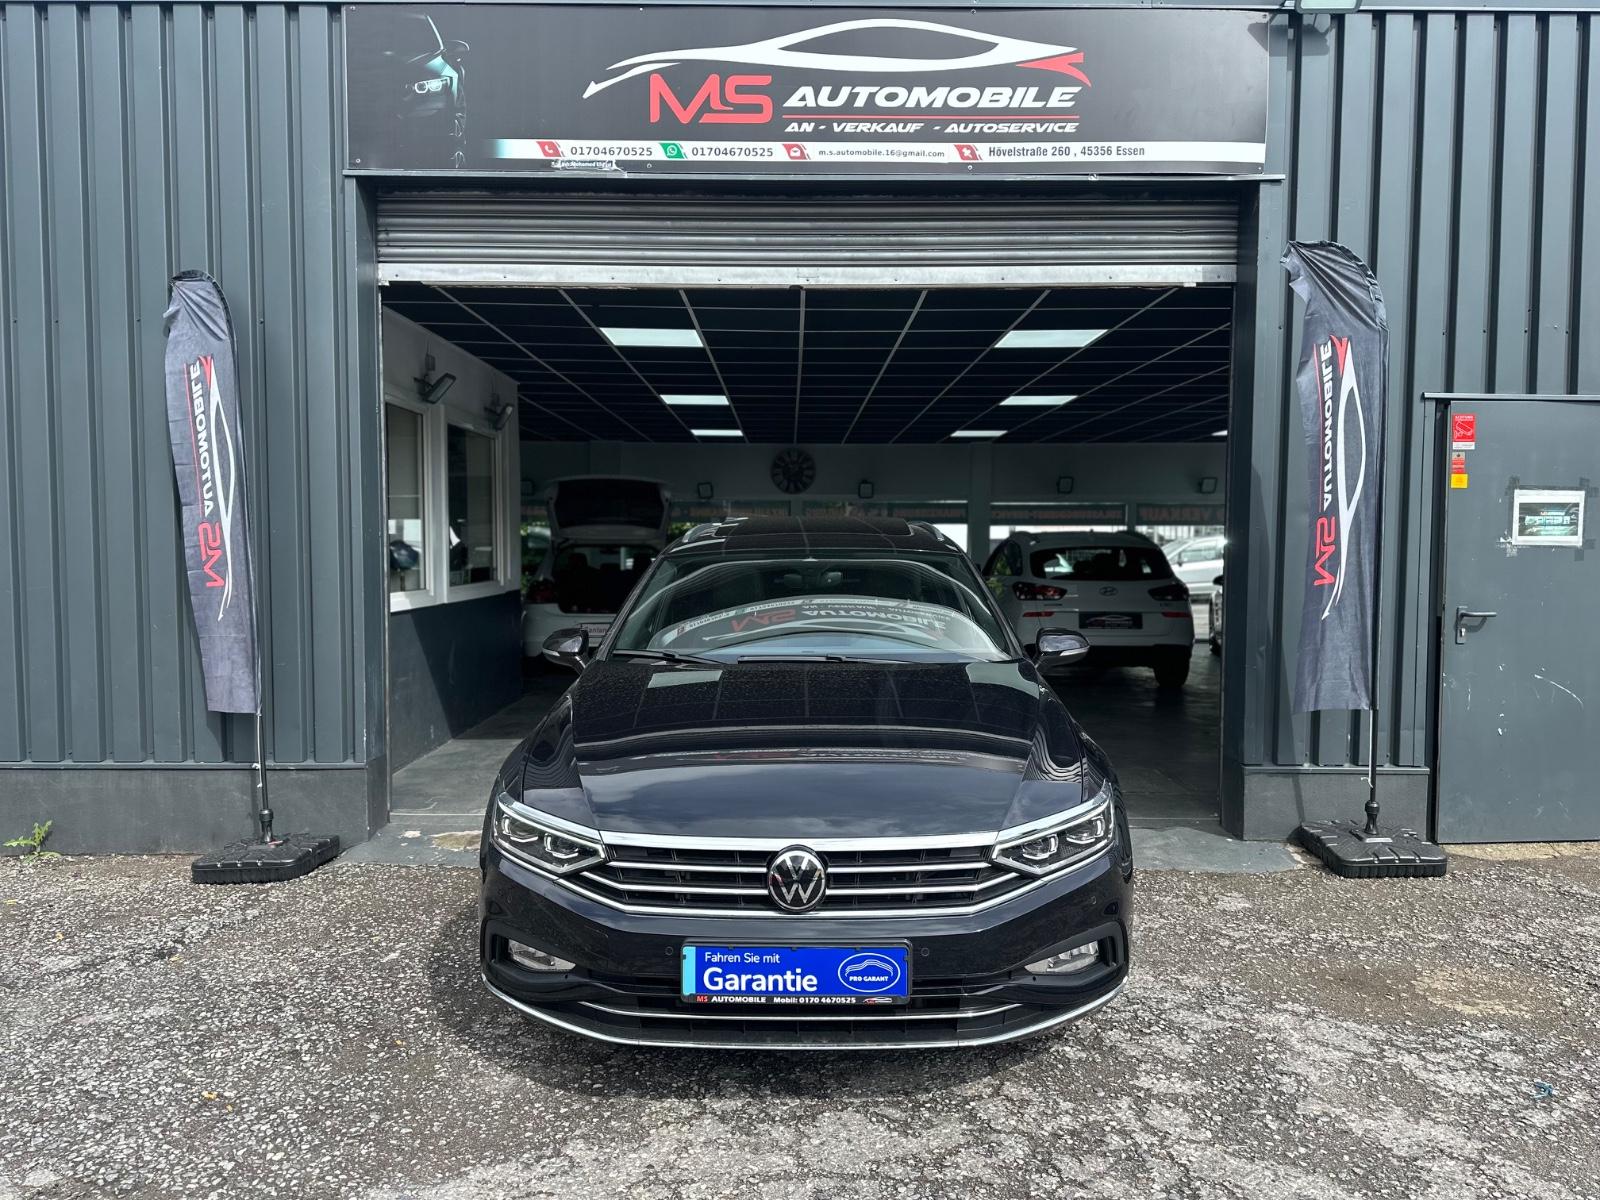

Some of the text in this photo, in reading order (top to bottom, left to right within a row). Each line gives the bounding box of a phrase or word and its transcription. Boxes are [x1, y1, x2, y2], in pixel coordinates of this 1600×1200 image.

[649, 74, 1081, 124] MS AUTOMOBILE
[785, 122, 815, 133] AN
[832, 122, 924, 133] VERKAUF
[944, 122, 1079, 133] AUTOSERVICE
[570, 146, 653, 156] 01704670525
[692, 147, 774, 157] 01704670525
[818, 148, 945, 158] m.s.automobile.16@gmail.com
[988, 146, 1048, 157] Hövelstraße
[1051, 146, 1071, 156] 260
[1080, 146, 1113, 156] 45356
[1116, 145, 1145, 156] Essen
[704, 951, 780, 964] Fahren Sie mit
[703, 966, 818, 992] Garantie
[696, 995, 708, 1003] MS
[711, 995, 766, 1003] AUTOMOBILE
[773, 996, 798, 1004] Mobil:
